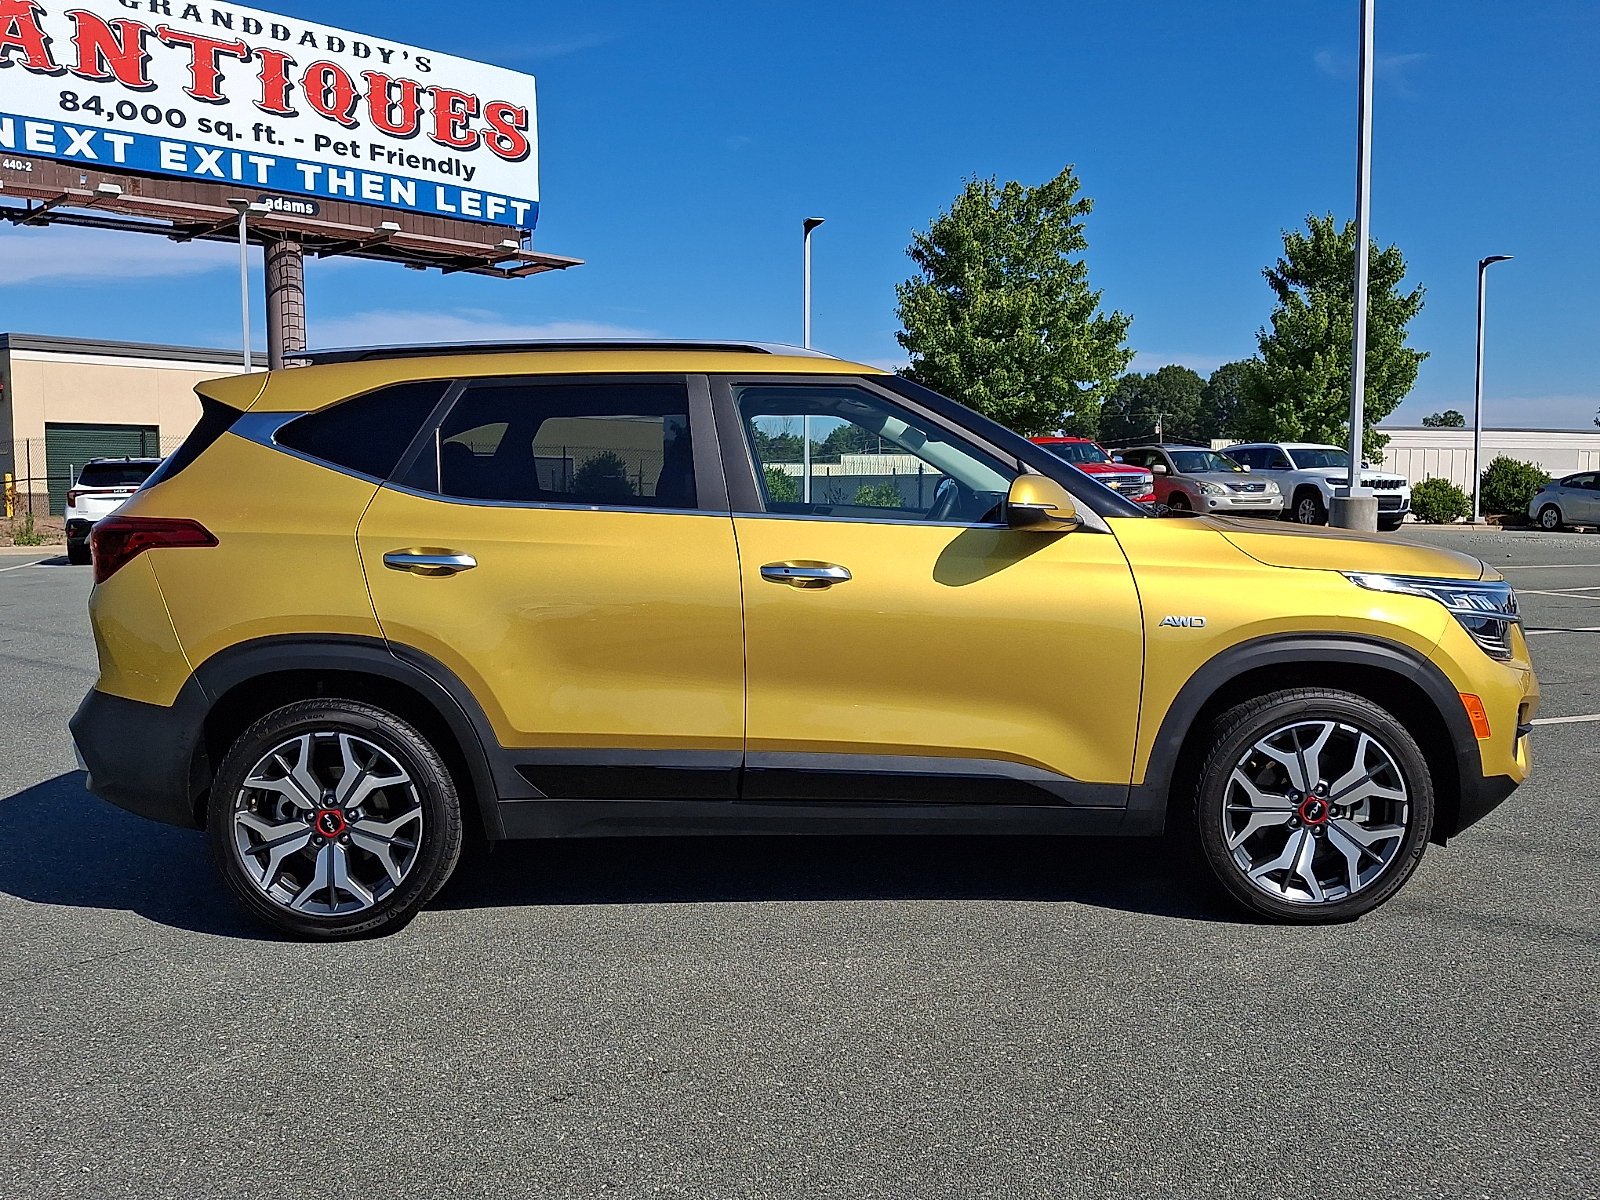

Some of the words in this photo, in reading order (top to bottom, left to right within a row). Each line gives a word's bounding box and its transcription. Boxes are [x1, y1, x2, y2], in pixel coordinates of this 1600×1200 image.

[0, 0, 530, 162] ANTIQUES
[59, 91, 187, 128] 84,000
[198, 117, 242, 141] sq.
[252, 123, 284, 145] ft.
[315, 134, 360, 158] Pet
[370, 143, 476, 181] Friendly
[160, 140, 276, 184] EXIT
[297, 163, 416, 206] THEN
[436, 185, 531, 226] LEFT
[264, 197, 314, 214] adams
[1159, 615, 1206, 627] AWD
